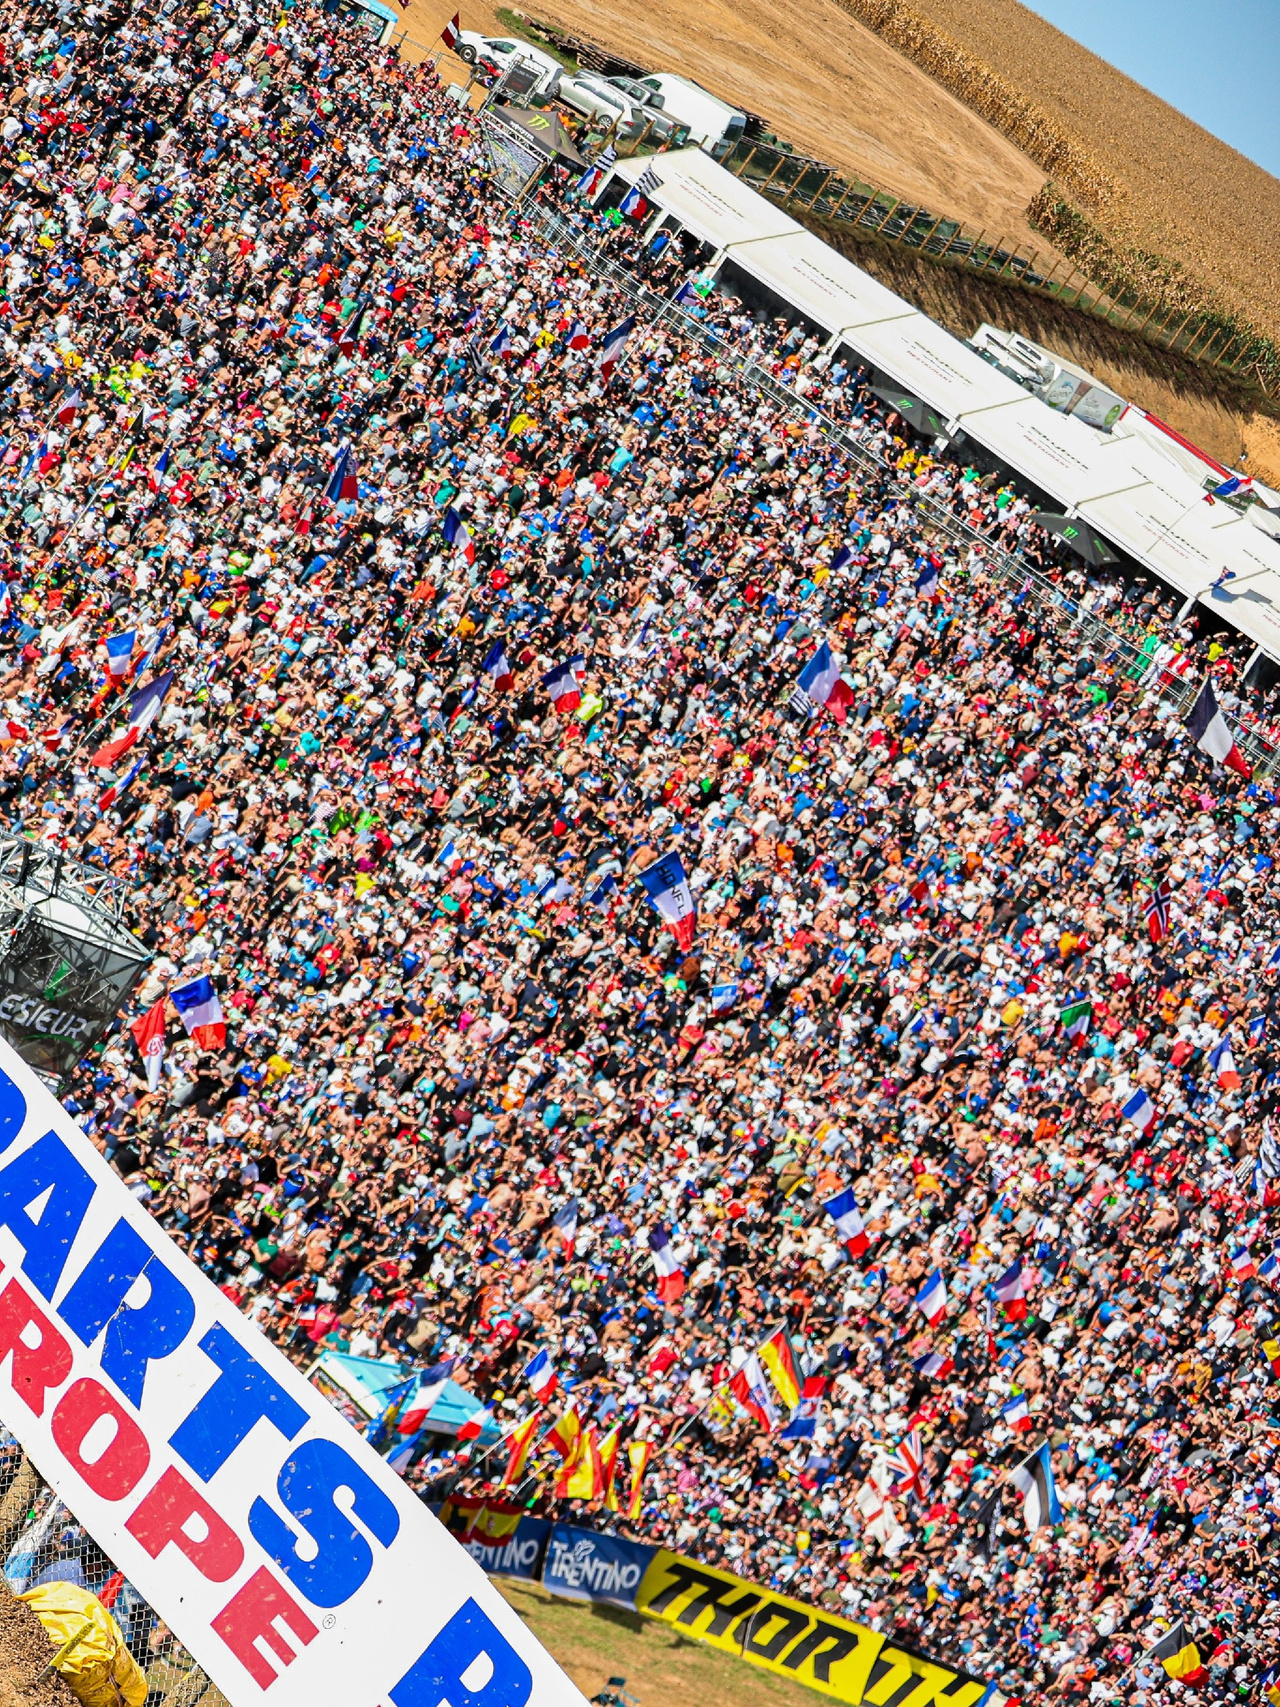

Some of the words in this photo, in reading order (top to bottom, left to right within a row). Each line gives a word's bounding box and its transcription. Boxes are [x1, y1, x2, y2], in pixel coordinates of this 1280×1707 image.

[470, 1537, 539, 1570] ENTINO
[551, 1540, 641, 1593] TRENTINO
[648, 1562, 860, 1684] THOR
